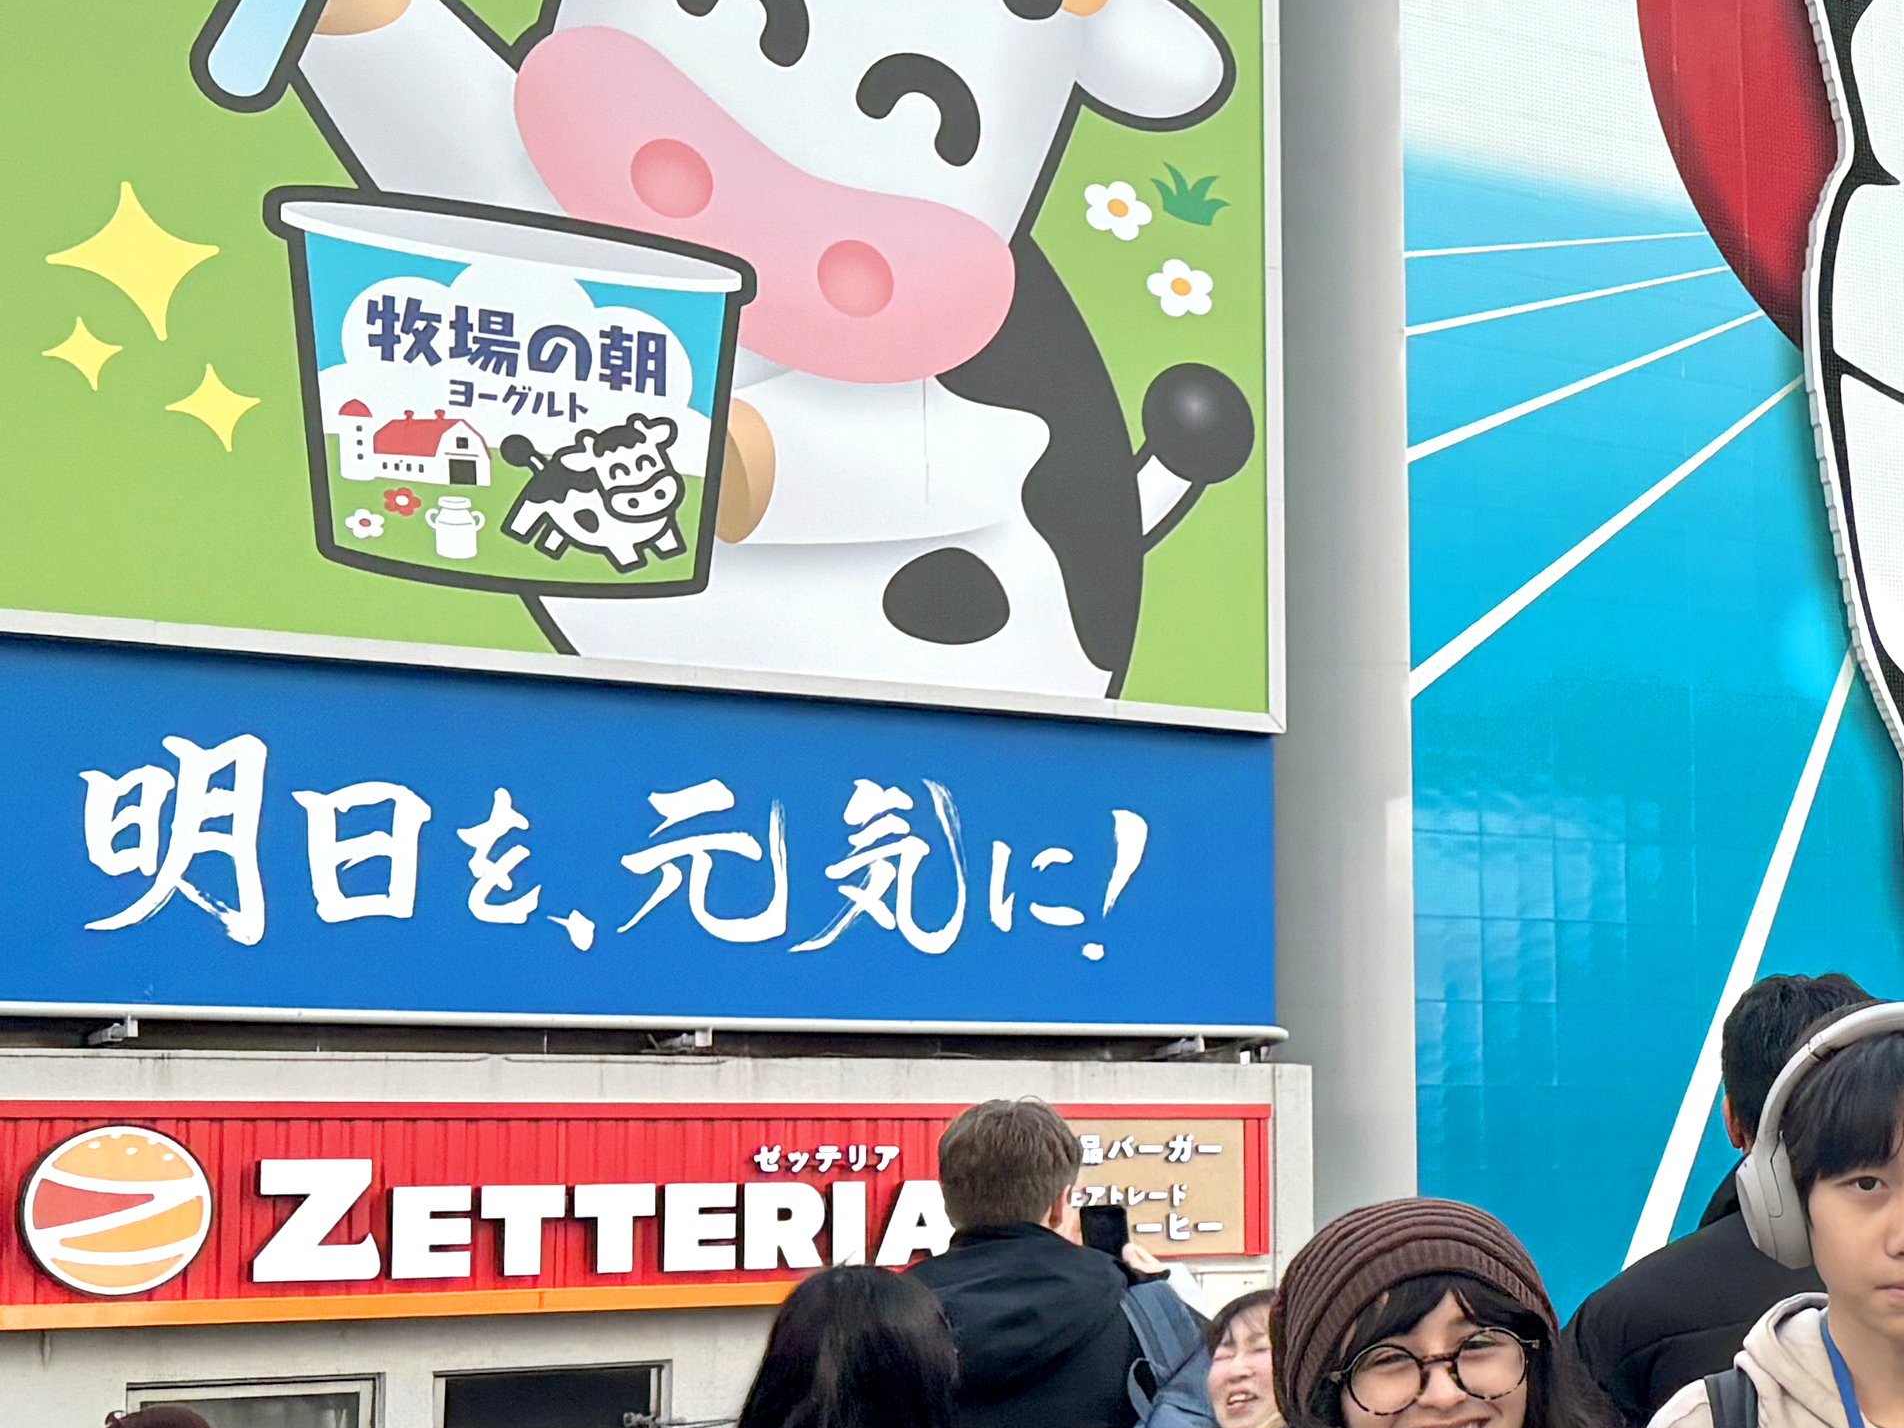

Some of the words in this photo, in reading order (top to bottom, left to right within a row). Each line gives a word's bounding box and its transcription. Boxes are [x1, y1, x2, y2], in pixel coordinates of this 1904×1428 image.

[366, 294, 668, 397] 牧場の朝
[448, 378, 590, 424] ヨーグルト
[78, 733, 1149, 963] 明日を、元気に!
[752, 1142, 902, 1174] ゼッテリア
[252, 1156, 957, 1285] ZETTERIA
